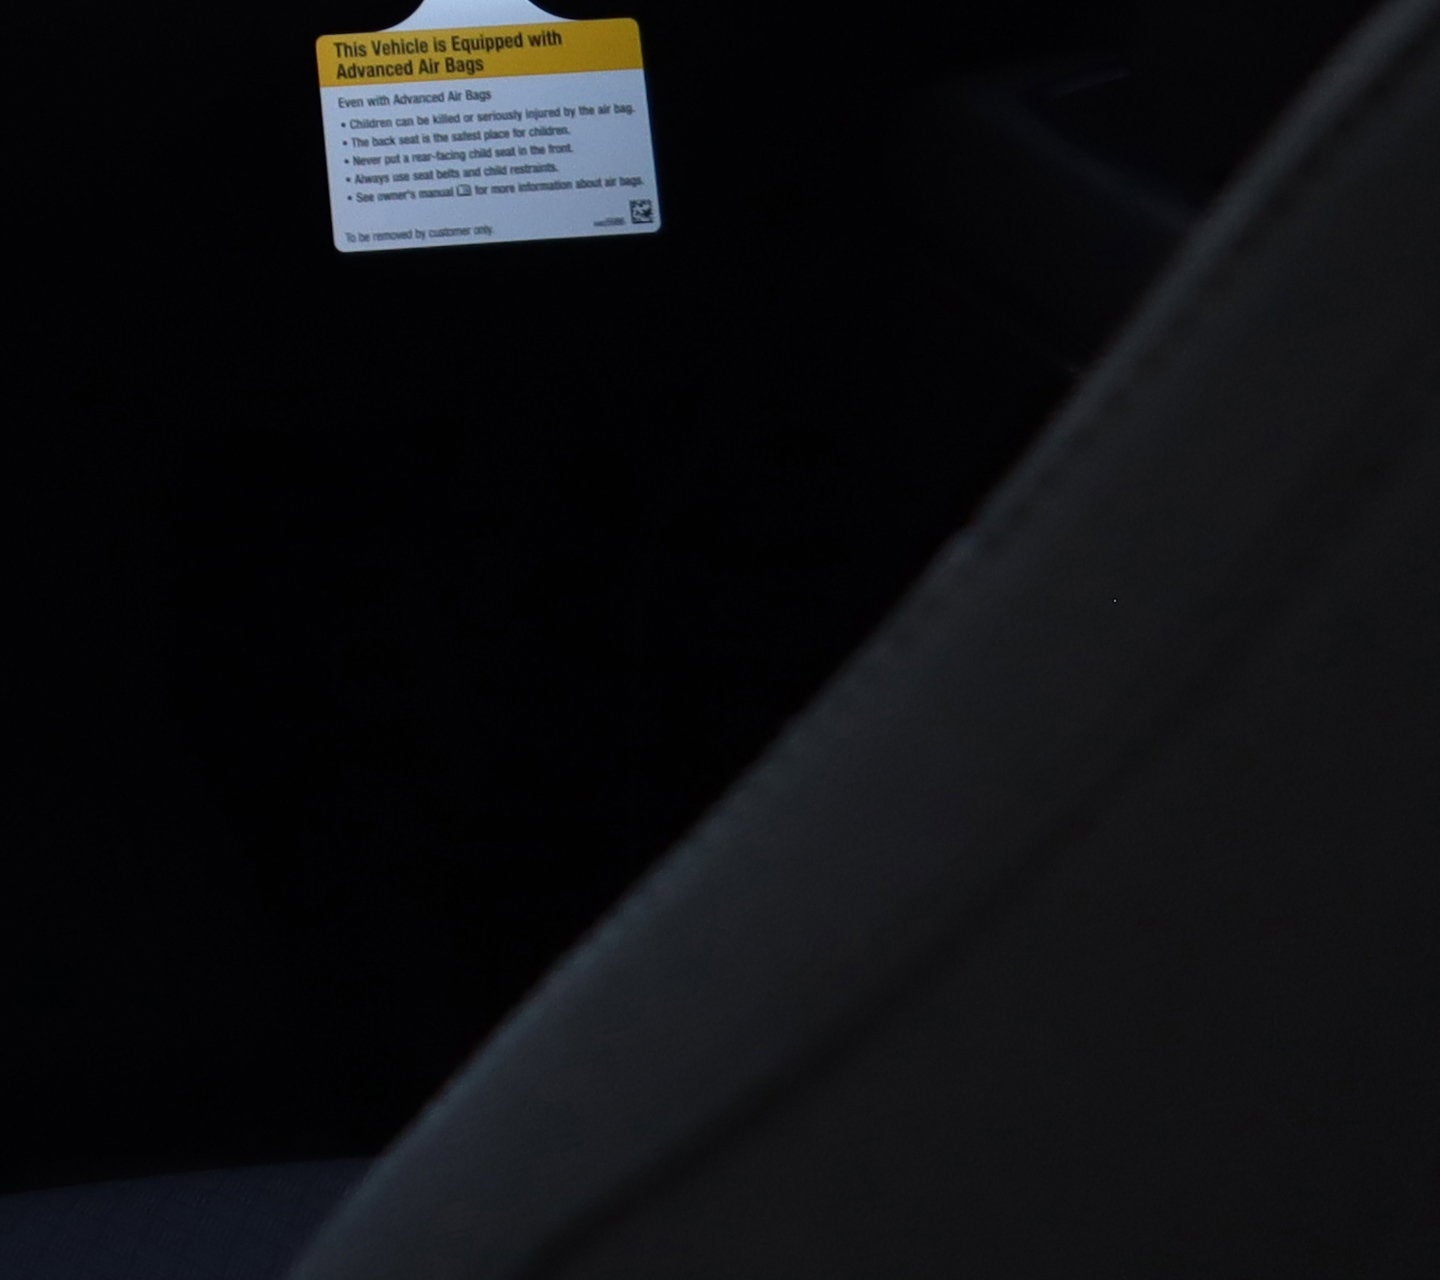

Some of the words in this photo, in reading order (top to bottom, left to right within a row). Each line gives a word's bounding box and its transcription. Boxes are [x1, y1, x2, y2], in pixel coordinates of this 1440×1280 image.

[334, 42, 367, 59] This
[371, 38, 428, 57] Vehicle
[433, 36, 447, 52] is
[452, 33, 523, 53] Equipped
[528, 30, 562, 48] with
[336, 57, 413, 79] Advanced
[419, 58, 440, 75] Air
[445, 56, 484, 76] Bags
[338, 96, 364, 108] Even
[367, 94, 390, 106] with
[393, 91, 445, 105] Advanced
[448, 90, 462, 102] Air
[465, 89, 491, 102] Bags
[349, 117, 392, 130] Children
[395, 117, 414, 127] can
[417, 115, 430, 126] be
[432, 112, 460, 124] killed
[464, 113, 473, 123] or
[477, 110, 522, 124] seriously
[525, 107, 561, 121] injured
[563, 106, 576, 119] by
[578, 104, 594, 116] the
[598, 104, 611, 115] air
[613, 102, 636, 117] bag.
[352, 137, 369, 148] The
[372, 136, 395, 147] back
[400, 135, 419, 146] seat
[422, 134, 431, 144] is
[433, 133, 449, 144] the
[452, 131, 481, 143] safest
[484, 129, 510, 143] place
[513, 128, 526, 139] for
[353, 155, 381, 166] Never
[385, 154, 400, 167] put
[412, 150, 466, 164] rear-facing
[468, 148, 493, 159] child
[495, 147, 515, 158] seat
[517, 146, 527, 156] in
[530, 145, 545, 156] the
[354, 173, 390, 186] Always
[393, 173, 410, 183] use
[413, 171, 433, 182] seat
[436, 169, 460, 180] belts
[463, 168, 481, 178] and
[484, 165, 508, 177] child
[356, 193, 374, 204] See
[377, 190, 416, 202] owner's
[419, 188, 454, 199] manual
[475, 186, 488, 196] for
[490, 185, 515, 195] more
[518, 181, 572, 193] information
[575, 178, 601, 190] about
[605, 177, 617, 188] air
[346, 233, 356, 243] To
[359, 232, 370, 242] be
[373, 230, 412, 241] removed
[415, 229, 426, 240] by
[429, 227, 471, 238] customer
